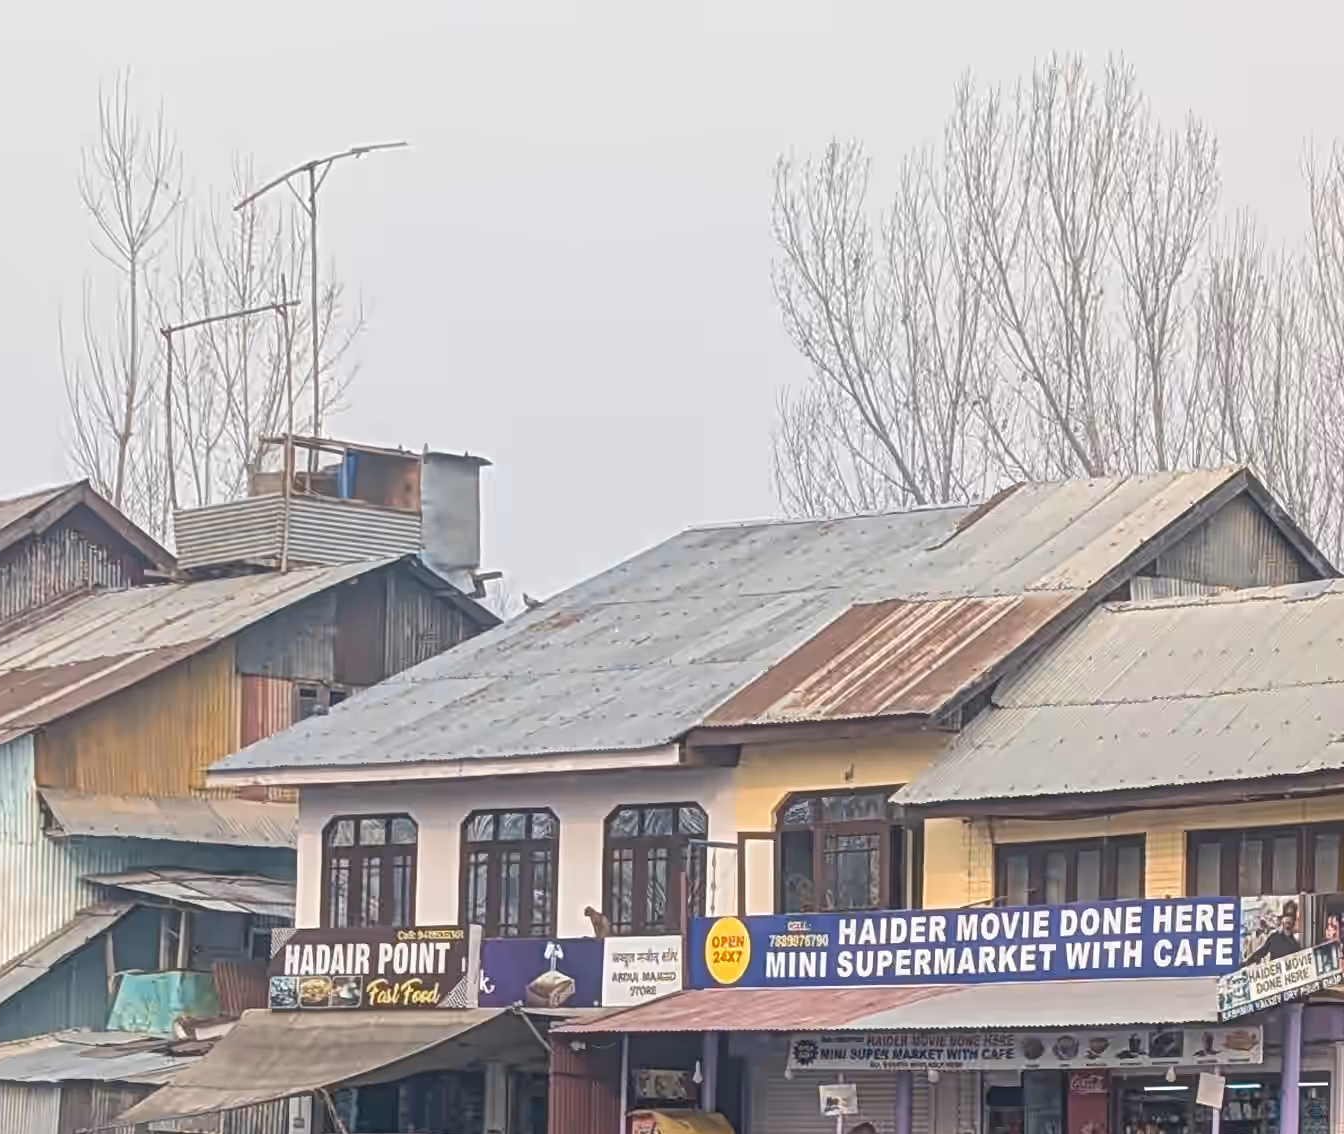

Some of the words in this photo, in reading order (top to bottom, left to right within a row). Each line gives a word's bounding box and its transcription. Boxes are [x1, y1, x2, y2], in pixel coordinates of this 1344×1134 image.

[838, 915, 947, 945] HAIDER
[956, 910, 1050, 942] MOVIE
[1059, 906, 1143, 937] DONE
[1152, 903, 1235, 933] HERE
[711, 935, 745, 949] OPEN
[284, 942, 371, 976] HADAIR
[377, 941, 451, 975] POINT
[765, 951, 828, 978] MINI
[837, 943, 1057, 978] SUPERMARKET
[1065, 939, 1143, 970] WITH
[1153, 937, 1233, 968] CAFE
[1249, 961, 1283, 983] HAIDER
[1256, 975, 1283, 994] DONE
[1285, 968, 1310, 987] HERE
[401, 977, 441, 1005] Food
[820, 1048, 847, 1060] MINI
[850, 1048, 889, 1060] SUPER
[893, 1048, 944, 1060] MARKET
[947, 1048, 978, 1060] WITH
[982, 1047, 1015, 1060] CAFE
